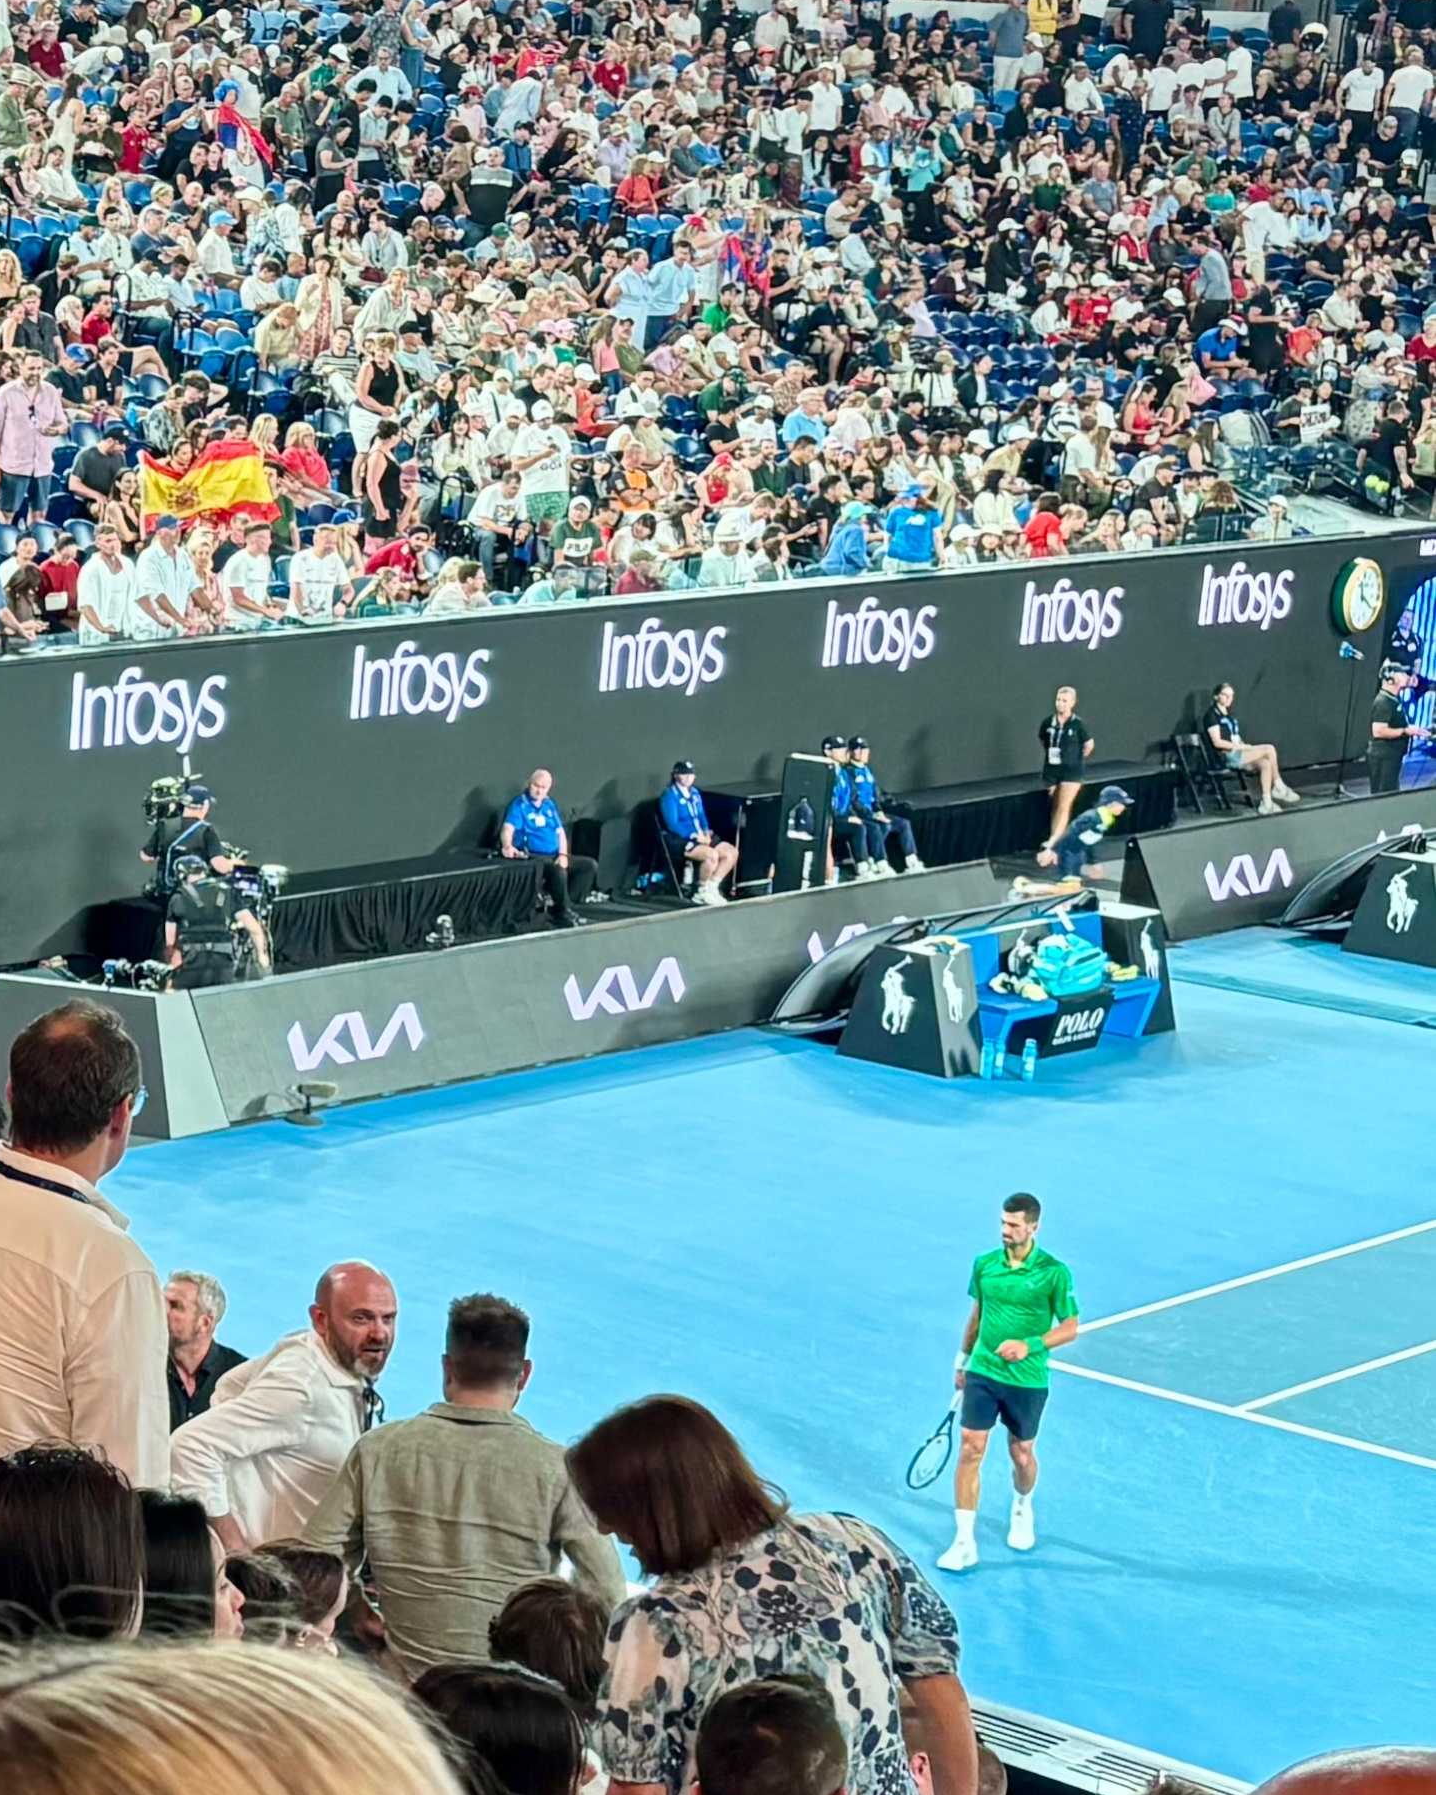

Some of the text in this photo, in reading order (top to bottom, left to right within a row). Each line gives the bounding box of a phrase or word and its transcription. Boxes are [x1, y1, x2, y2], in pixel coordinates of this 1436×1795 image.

[69, 667, 227, 753] Infosys
[349, 640, 491, 723] Infosys
[598, 617, 728, 695] Infosys
[821, 596, 938, 672] Infosys
[1019, 578, 1125, 650] Infosys
[1197, 561, 1295, 631] Infosys
[287, 847, 1294, 1072] KIA KIA KIA
[1055, 1007, 1105, 1037] POLO
